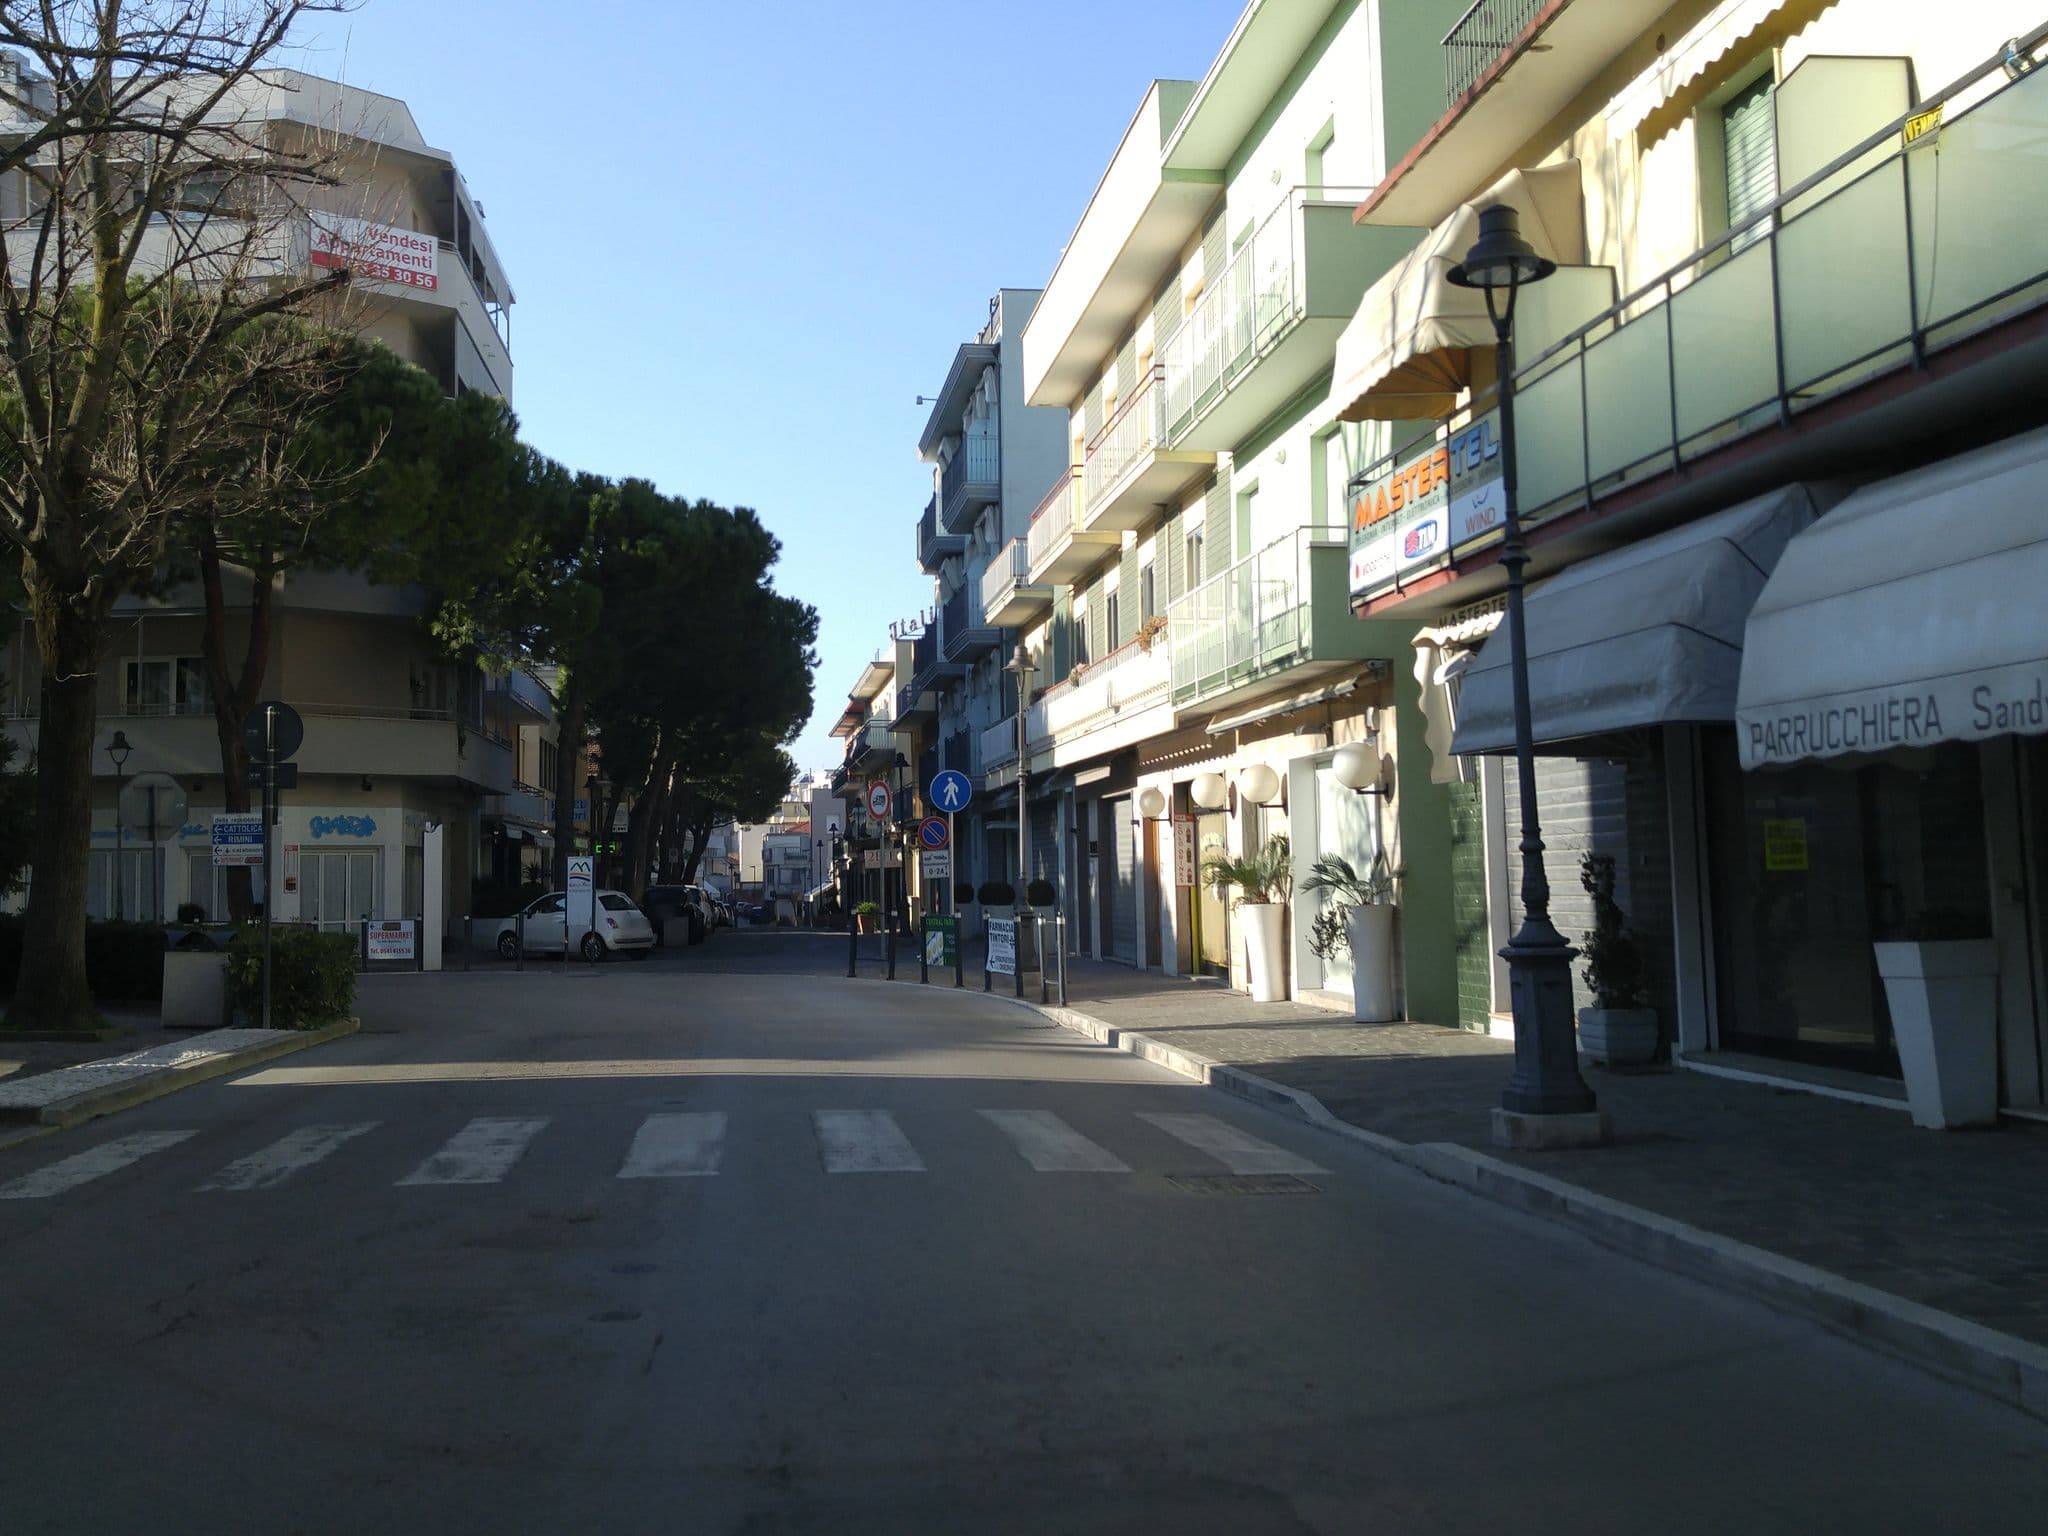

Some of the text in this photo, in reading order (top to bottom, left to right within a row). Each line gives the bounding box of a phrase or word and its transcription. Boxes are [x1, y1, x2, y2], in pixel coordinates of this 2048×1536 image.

[368, 228, 432, 253] Vendesi
[394, 269, 411, 283] 30
[415, 272, 433, 287] 56
[1353, 421, 1500, 535] MASTERTEL
[1465, 506, 1496, 535] WIND
[1750, 677, 2048, 761] PARRUCCHIERA Sand
[223, 825, 262, 833] CATTOLICA
[228, 835, 253, 843] RIMINI
[369, 931, 413, 940] SUPERMARKET
[989, 921, 1014, 933] FARMACIA
